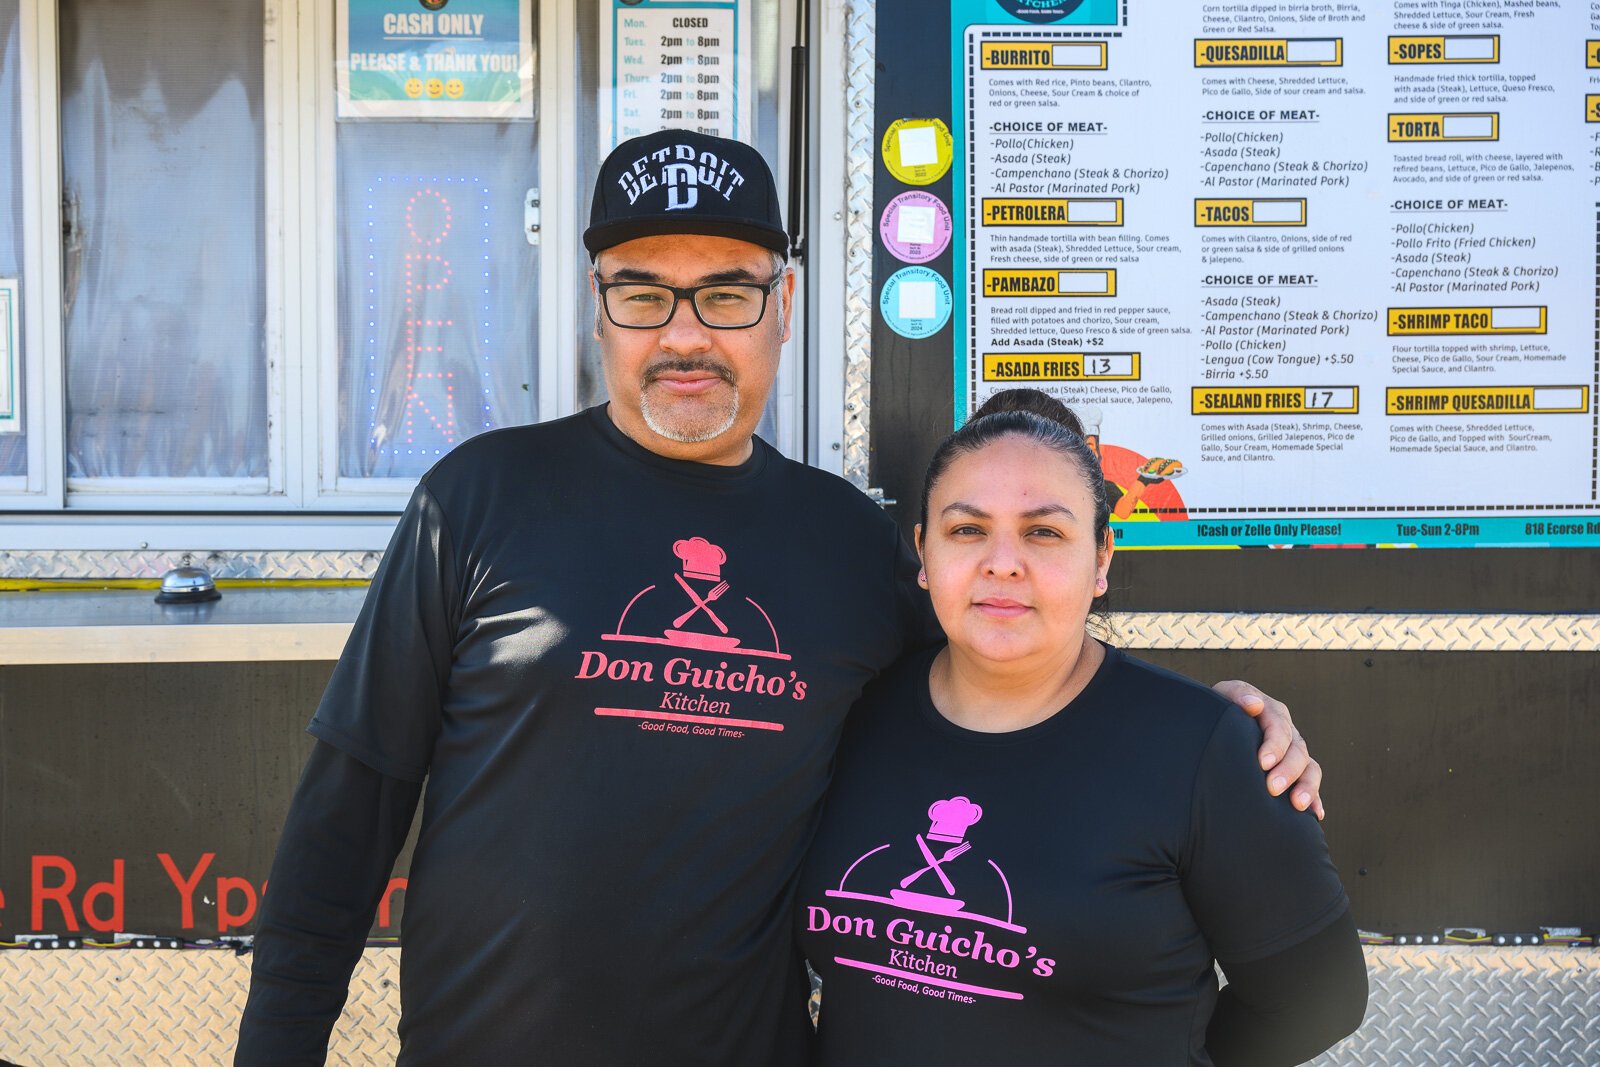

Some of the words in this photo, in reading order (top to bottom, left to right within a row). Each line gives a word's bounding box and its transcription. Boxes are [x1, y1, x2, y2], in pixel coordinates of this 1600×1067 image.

[384, 14, 433, 34] CASH
[438, 14, 484, 35] ONLY
[624, 19, 647, 28] Mon.
[673, 18, 708, 28] CLOSED
[661, 36, 682, 47] 2pm
[686, 38, 695, 46] to
[697, 36, 719, 47] 8pm
[986, 50, 1050, 66] -BURRITO
[1201, 46, 1284, 62] -QUESADILLA
[1394, 44, 1441, 59] -SOPES
[351, 53, 405, 71] PLEASE
[410, 56, 421, 71] &
[424, 54, 477, 72] THANK
[481, 54, 517, 72] YOU!
[661, 55, 682, 65] 2pm
[686, 56, 695, 64] to
[697, 55, 719, 65] 8pm
[661, 73, 682, 84] 2pm
[686, 75, 695, 83] to
[697, 73, 719, 84] 8pm
[1036, 78, 1050, 86] Red
[1119, 79, 1151, 87] Cilantro,
[661, 90, 682, 100] 2pm
[686, 92, 695, 100] to
[697, 90, 719, 101] 8pm
[661, 108, 682, 119] 2pm
[686, 110, 695, 118] to
[697, 109, 719, 120] 8pm
[1202, 111, 1254, 120] -CHOICE
[1259, 111, 1275, 120] OF
[1280, 110, 1319, 120] MEAT-
[990, 122, 1042, 131] -CHOICE
[1047, 122, 1063, 132] OF
[1068, 122, 1107, 132] MEAT-
[1392, 122, 1440, 137] -TORTA
[990, 138, 1074, 151] -Pollo(Chicken)
[990, 153, 1028, 163] -Asada
[1032, 154, 1071, 165] (Steak)
[618, 145, 744, 205] DETROIT
[991, 168, 1071, 180] -Campenchano
[1074, 168, 1109, 180] (Steak
[1112, 168, 1120, 178] &
[1124, 168, 1168, 180] Chorizo)
[665, 163, 699, 211] D
[991, 183, 1005, 192] -Al
[1009, 183, 1044, 193] Pastor
[1047, 183, 1108, 195] (Marinated
[1111, 183, 1140, 195] Pork)
[883, 203, 897, 226] Special
[898, 193, 932, 204] Transitory
[933, 200, 946, 215] Food
[1390, 200, 1442, 210] -CHOICE
[1448, 200, 1464, 209] OF
[1468, 199, 1508, 208] MEAT-
[987, 206, 1065, 220] -PETROLERA
[1201, 206, 1249, 222] -TACOS
[1392, 223, 1474, 235] -Pollo(Chicken)
[1392, 238, 1422, 248] -Pollo
[1426, 238, 1450, 248] Frito
[1454, 237, 1486, 249] (Fried
[1489, 237, 1536, 248] Chicken)
[987, 277, 1055, 292] -PAMBAZO
[1201, 276, 1253, 284] -CHOICE
[1258, 275, 1274, 284] OF
[1279, 275, 1318, 284] MEAT-
[883, 279, 896, 305] Special
[896, 268, 930, 279] Transitory
[932, 273, 946, 289] Food
[1201, 296, 1238, 306] -Asada
[1241, 296, 1280, 308] (Steak)
[407, 190, 452, 442] OPEN
[1201, 311, 1280, 322] -Campenchano
[1284, 310, 1318, 322] (Steak
[1322, 310, 1329, 320] &
[1333, 310, 1378, 322] Chorizo)
[1393, 314, 1450, 329] -SHRIMP
[1454, 314, 1488, 328] TACO
[1201, 326, 1216, 335] -Al
[1219, 326, 1254, 335] Pastor
[1257, 325, 1317, 337] (Marinated
[1320, 325, 1349, 336] Pork)
[991, 338, 1010, 346] Add
[1013, 338, 1044, 346] Asada
[1047, 338, 1082, 347] (Steak)
[1201, 340, 1232, 350] -Pollo
[1236, 340, 1286, 352] (Chicken)
[1442, 345, 1468, 353] topped
[1470, 344, 1487, 352] with
[1489, 344, 1518, 352] shrimp,
[1520, 344, 1550, 352] Lettuce,
[1092, 359, 1111, 374] 13
[1201, 355, 1244, 367] -Lengua
[1248, 354, 1274, 366] (Cow
[1278, 354, 1320, 366] Tongue)
[991, 362, 1040, 377] -ASADA
[1044, 362, 1079, 376] FRIES
[1201, 369, 1235, 379] -Birria
[1200, 394, 1262, 408] -SEALAND
[1266, 393, 1301, 408] FRIES
[1312, 391, 1334, 407] 17
[1391, 395, 1449, 410] -SHRIMP
[1452, 394, 1530, 412] QUESADILLA
[1271, 423, 1300, 432] (Steak),
[1303, 423, 1332, 431] Shrimp,
[1231, 526, 1242, 536] or
[1245, 524, 1271, 536] Zelle
[1274, 524, 1298, 537] Only
[1301, 523, 1341, 535] Please!
[1396, 524, 1442, 536] Tue-Sun
[1444, 523, 1479, 536] 2-8Pm
[1525, 523, 1544, 535] 818
[1547, 523, 1584, 535] Ecorse
[575, 651, 653, 682] Don
[663, 658, 807, 700] Guicho's
[659, 692, 730, 714] Kitchen
[638, 721, 664, 731] -Good
[666, 723, 689, 734] Food,
[692, 726, 715, 736] Good
[718, 728, 745, 738] Times-
[31, 854, 124, 932] Rd
[807, 906, 876, 938] Don
[886, 918, 1056, 977] Guicho's
[888, 949, 957, 978] Kitchen
[872, 974, 896, 987] -Good
[898, 980, 920, 995] Food,
[922, 986, 945, 999] Good
[948, 991, 976, 1004] Times-
